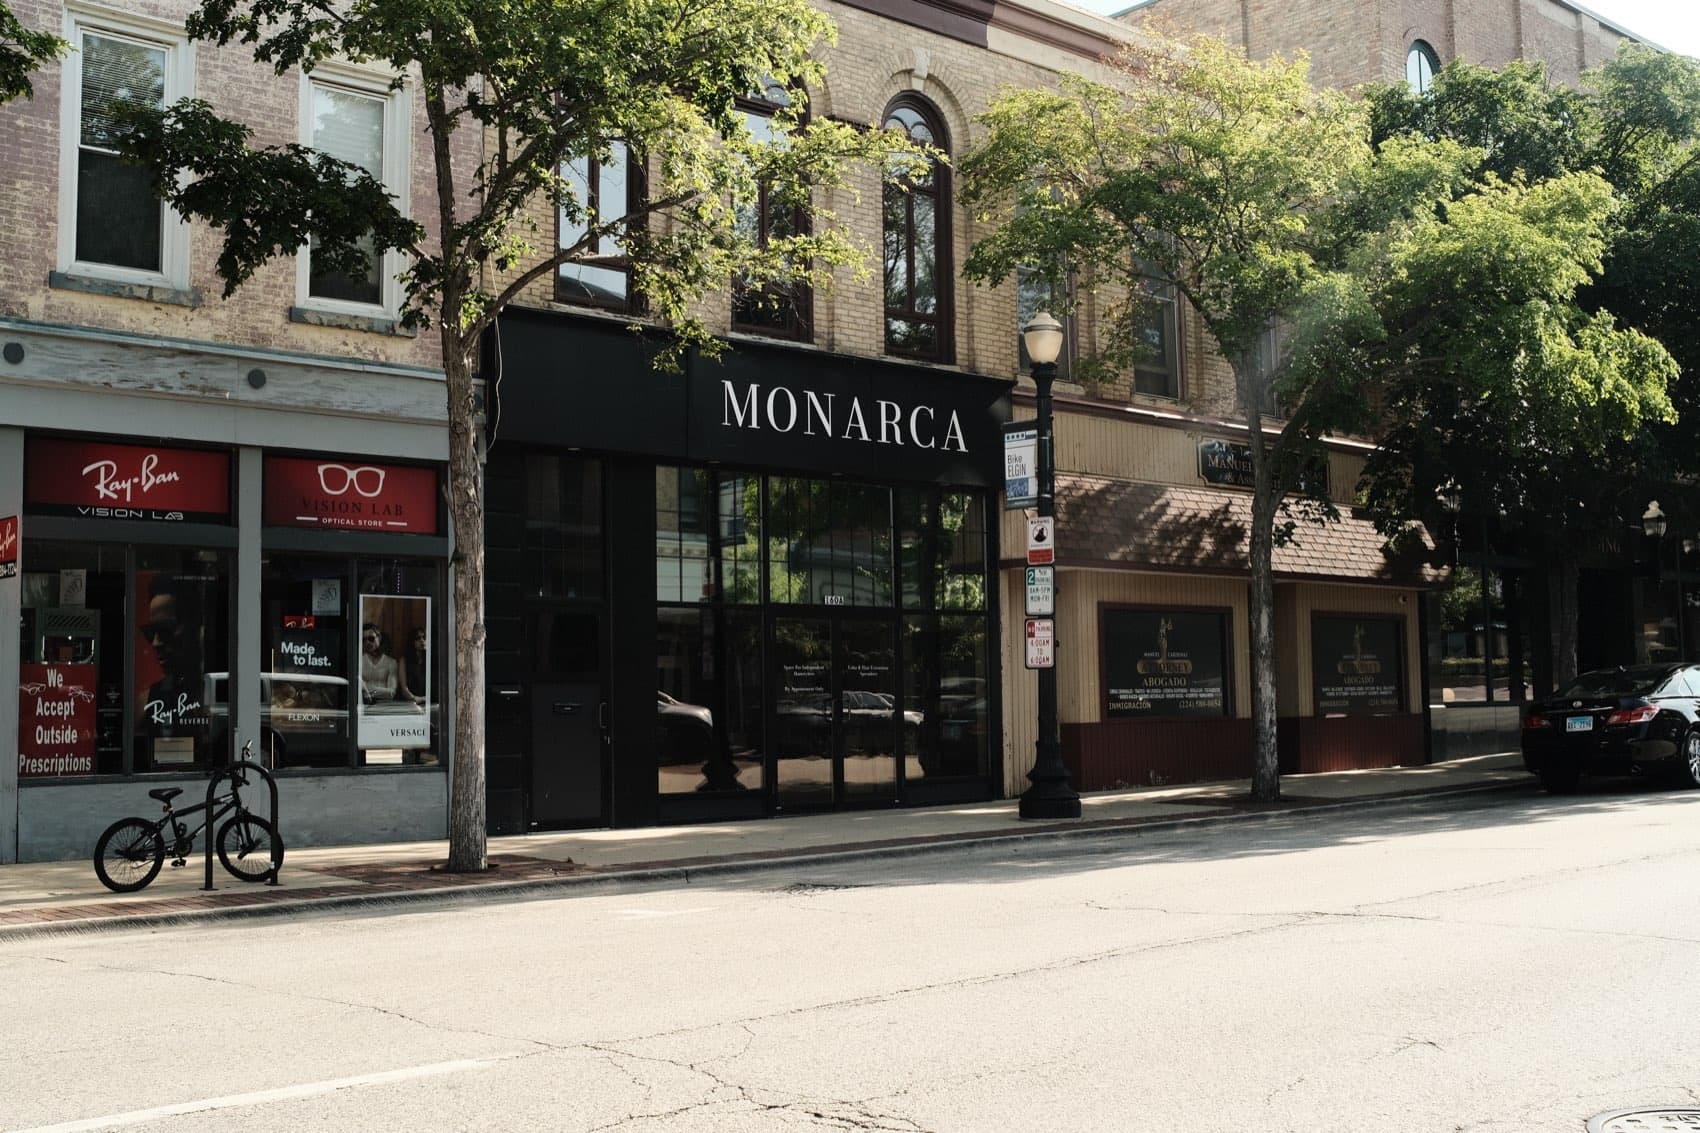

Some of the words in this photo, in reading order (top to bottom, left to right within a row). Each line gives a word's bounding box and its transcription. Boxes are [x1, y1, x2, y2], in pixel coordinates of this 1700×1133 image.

[721, 379, 969, 453] MONARCA
[1007, 454, 1023, 464] Bike
[82, 453, 180, 503] Ray-Ban
[1007, 463, 1027, 478] ELGIN
[77, 506, 143, 519] VISION
[302, 497, 363, 514] VISION
[371, 503, 404, 517] LAB
[322, 517, 355, 526] OPTICAL
[358, 519, 383, 527] STORE
[280, 641, 316, 655] Made
[293, 654, 305, 666] to
[308, 654, 332, 667] last.
[46, 667, 64, 688] We
[1143, 676, 1187, 688] ABOGADO
[35, 696, 75, 720] Accept
[144, 692, 200, 724] Ray-Ban
[288, 713, 320, 722] FLEXON
[35, 723, 78, 745] Outside
[18, 753, 93, 776] Prescriptions
